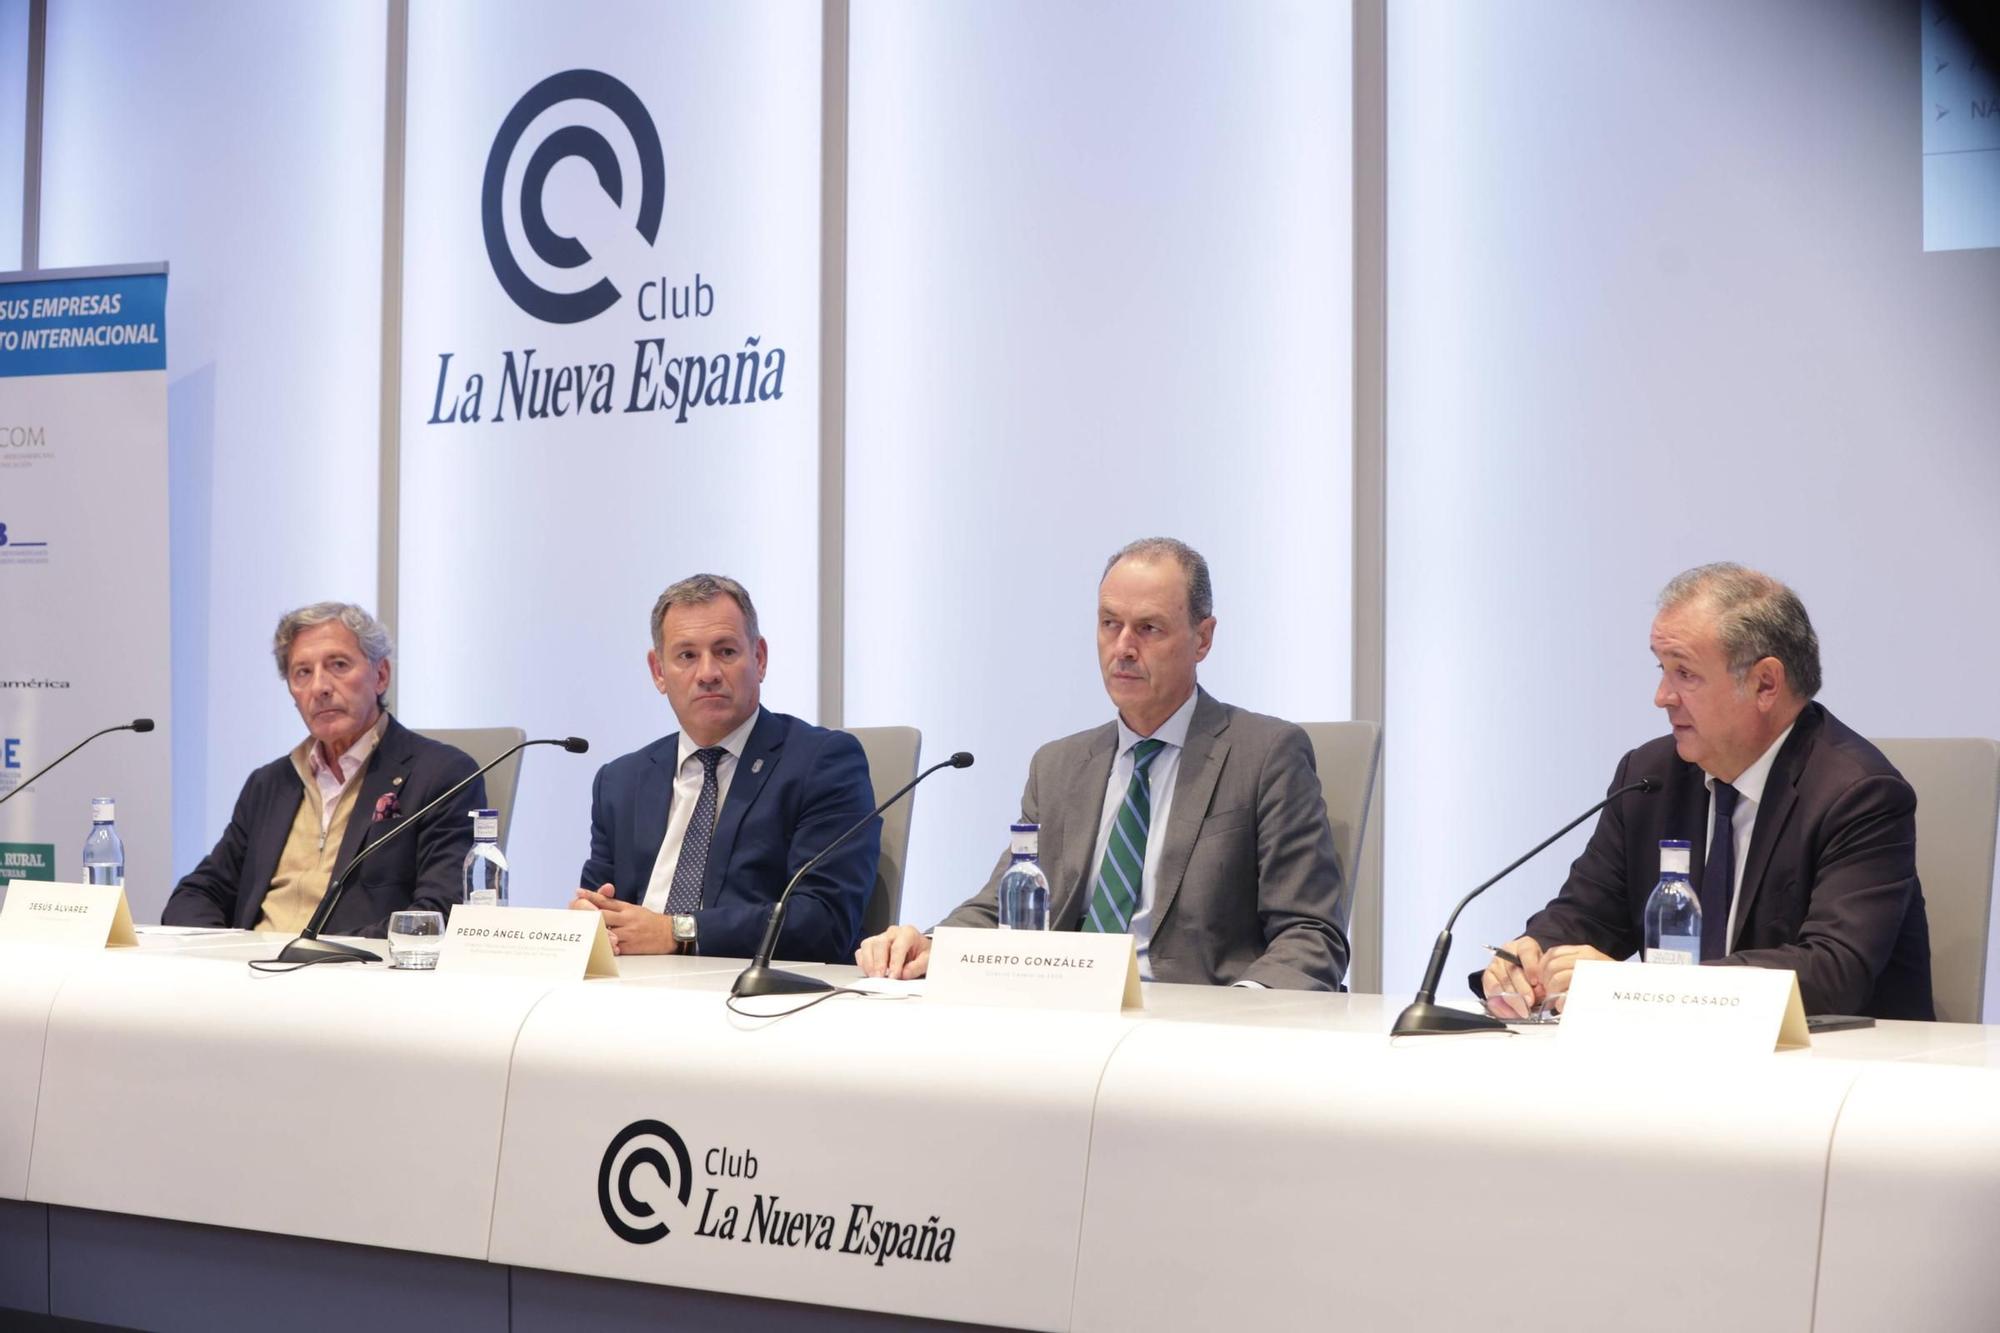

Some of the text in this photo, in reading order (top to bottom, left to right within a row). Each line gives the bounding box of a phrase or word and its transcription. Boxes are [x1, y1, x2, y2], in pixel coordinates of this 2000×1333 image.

[32, 293, 122, 319] EMPRESAS
[638, 273, 714, 321] Club
[21, 323, 159, 350] INTERNACIONAL
[427, 335, 786, 424] La Nueva España
[4, 852, 45, 867] RURAL
[457, 927, 490, 938] PEDRO
[960, 953, 1095, 969] ALBERTO GONZÁLEZ
[1612, 991, 1741, 1007] NARCISO CASADO
[705, 1147, 758, 1179] Club
[694, 1187, 956, 1266] La Nueva España
